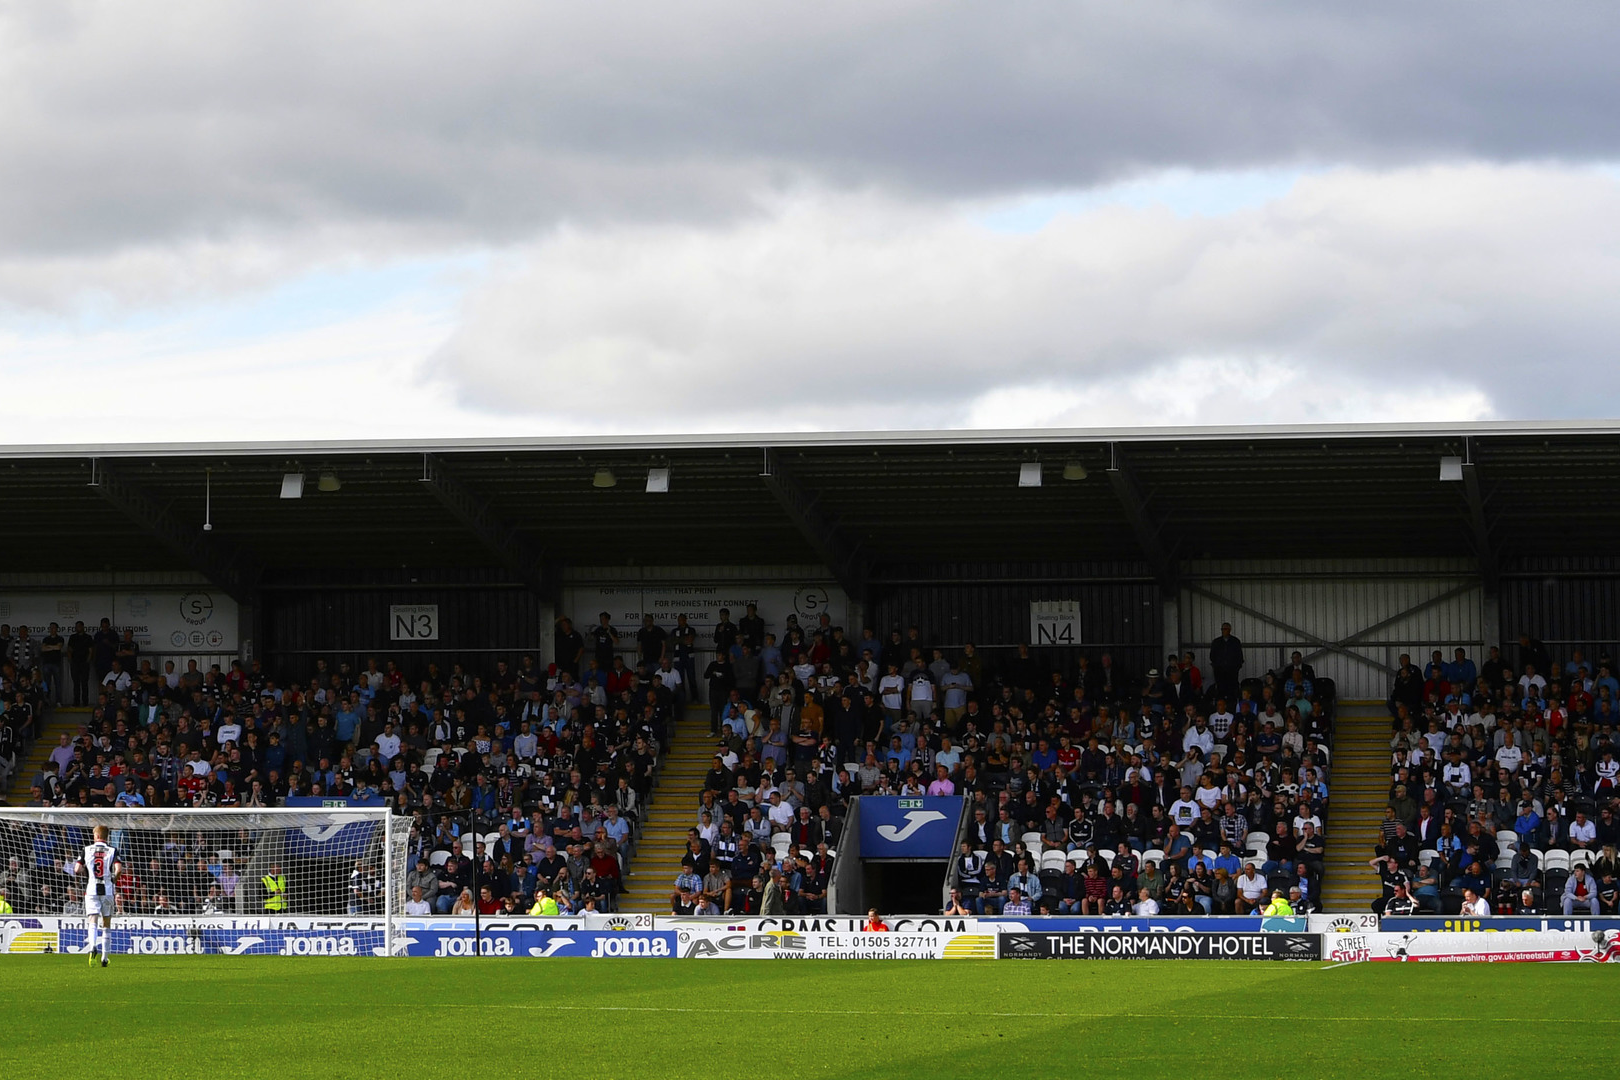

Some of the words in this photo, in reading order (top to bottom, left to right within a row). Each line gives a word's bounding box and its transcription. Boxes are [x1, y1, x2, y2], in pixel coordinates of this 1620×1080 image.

[396, 614, 433, 638] N3
[1038, 622, 1074, 645] N4
[94, 858, 104, 878] 3
[635, 915, 651, 926] 28
[1360, 915, 1377, 927] 29
[683, 934, 807, 959] ACRE
[818, 936, 849, 948] TEL:
[852, 936, 891, 948] 01505
[894, 936, 937, 948] 327711
[1046, 936, 1085, 955] THE
[1090, 936, 1205, 955] NORMANDY
[1208, 936, 1274, 956] HOTEL
[1336, 936, 1367, 952] STREET
[773, 949, 937, 960] www.acreindustrial.co.uk
[1331, 948, 1371, 962] STUFF
[1418, 951, 1555, 963] www.renfrewshire.gov.uk/streetstuff
